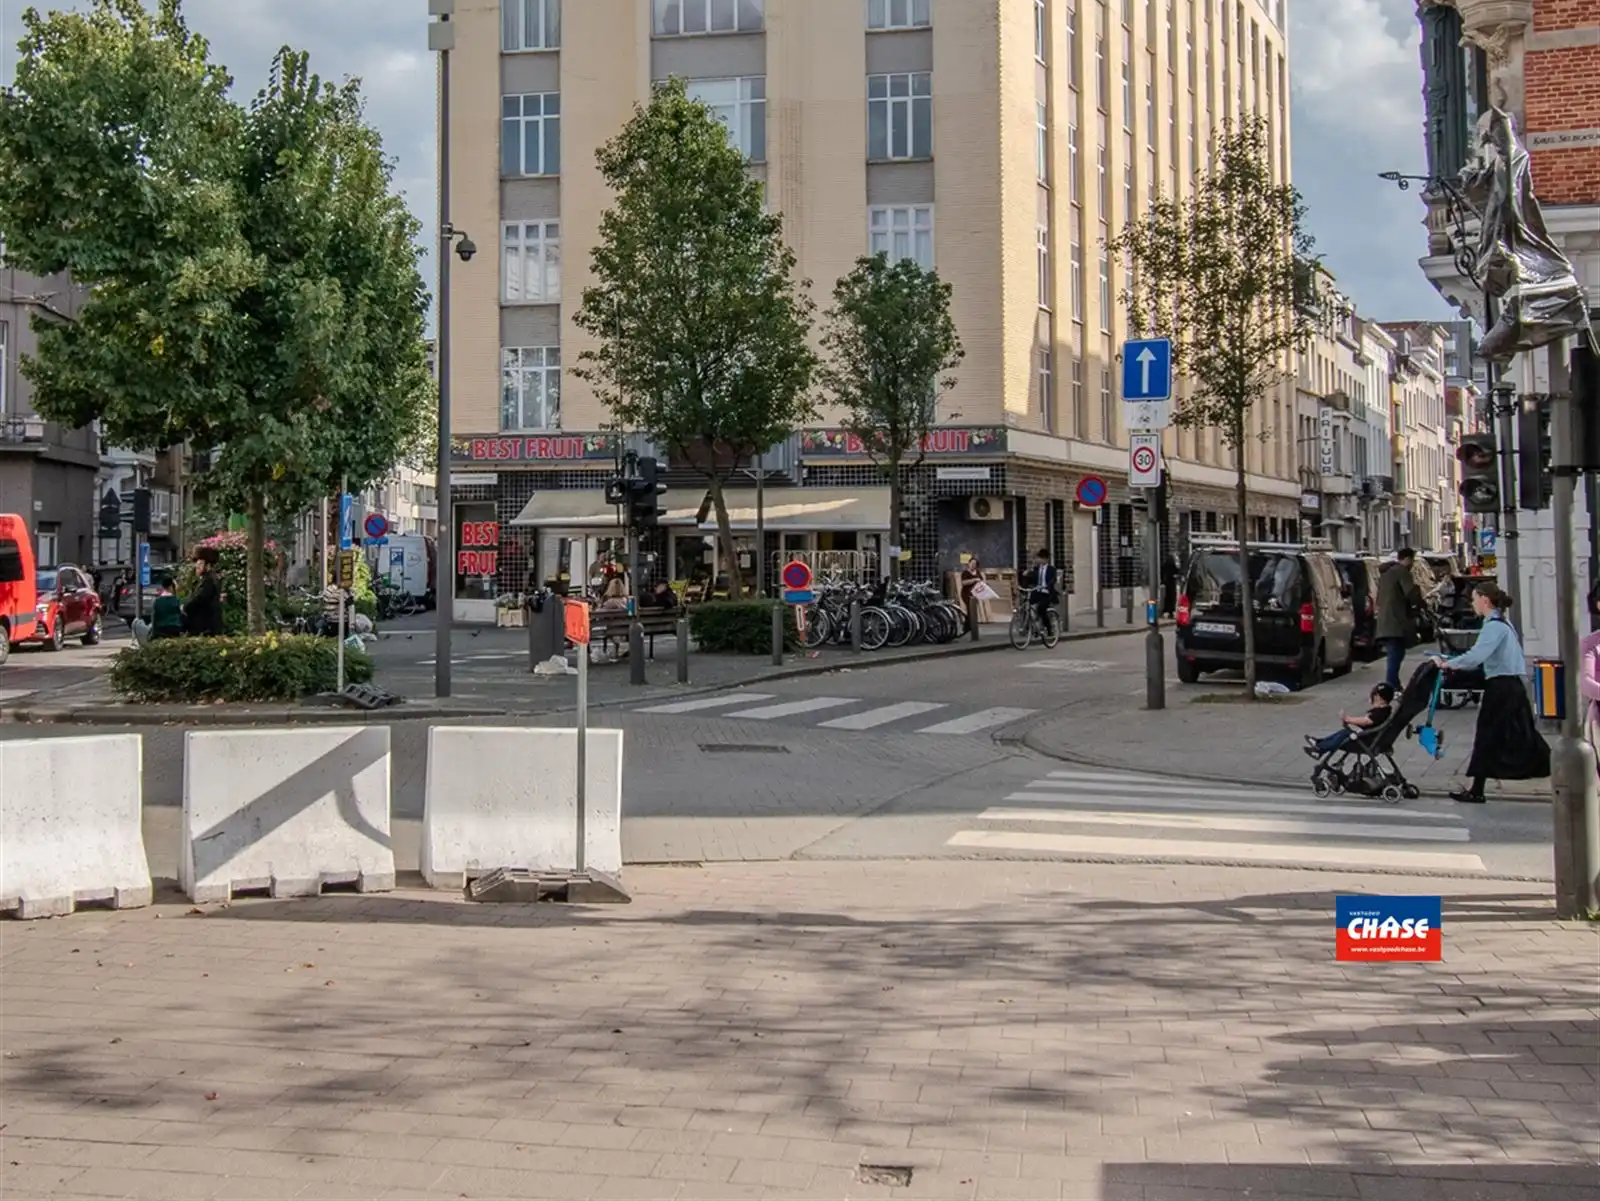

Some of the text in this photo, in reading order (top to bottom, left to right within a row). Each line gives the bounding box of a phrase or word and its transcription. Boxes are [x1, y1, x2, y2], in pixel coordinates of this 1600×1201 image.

[472, 437, 584, 459] BEST FRUIT
[917, 429, 969, 452] RUIT
[1136, 437, 1153, 445] ZONE
[1137, 454, 1151, 466] 30
[463, 521, 499, 545] BEST
